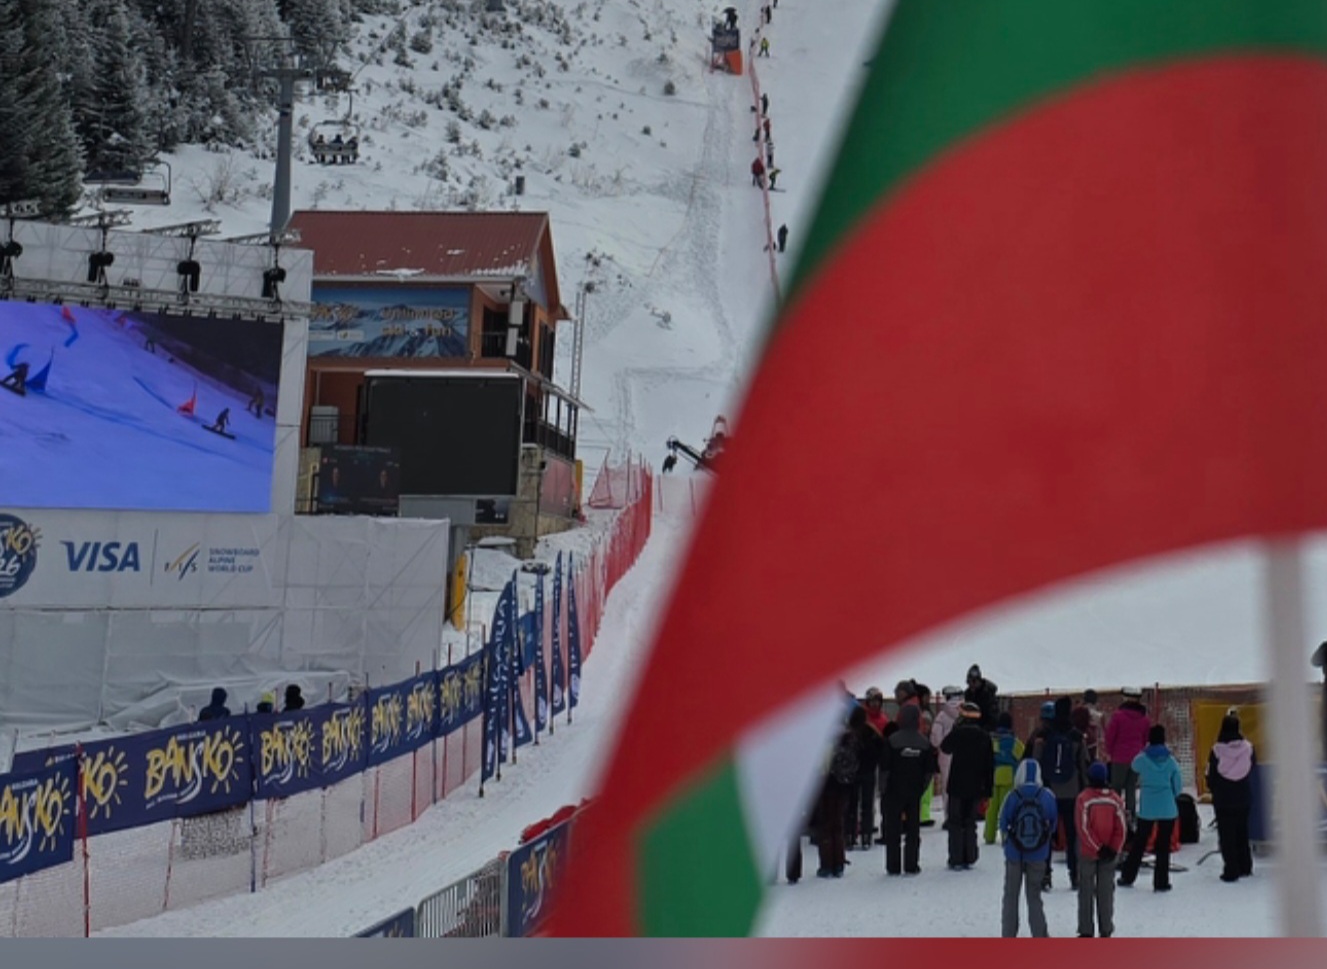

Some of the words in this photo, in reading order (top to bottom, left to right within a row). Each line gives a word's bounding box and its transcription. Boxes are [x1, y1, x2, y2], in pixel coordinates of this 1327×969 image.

[59, 540, 141, 572] VISA
[144, 731, 234, 804] BANSKO
[0, 778, 63, 864] ANSKO
